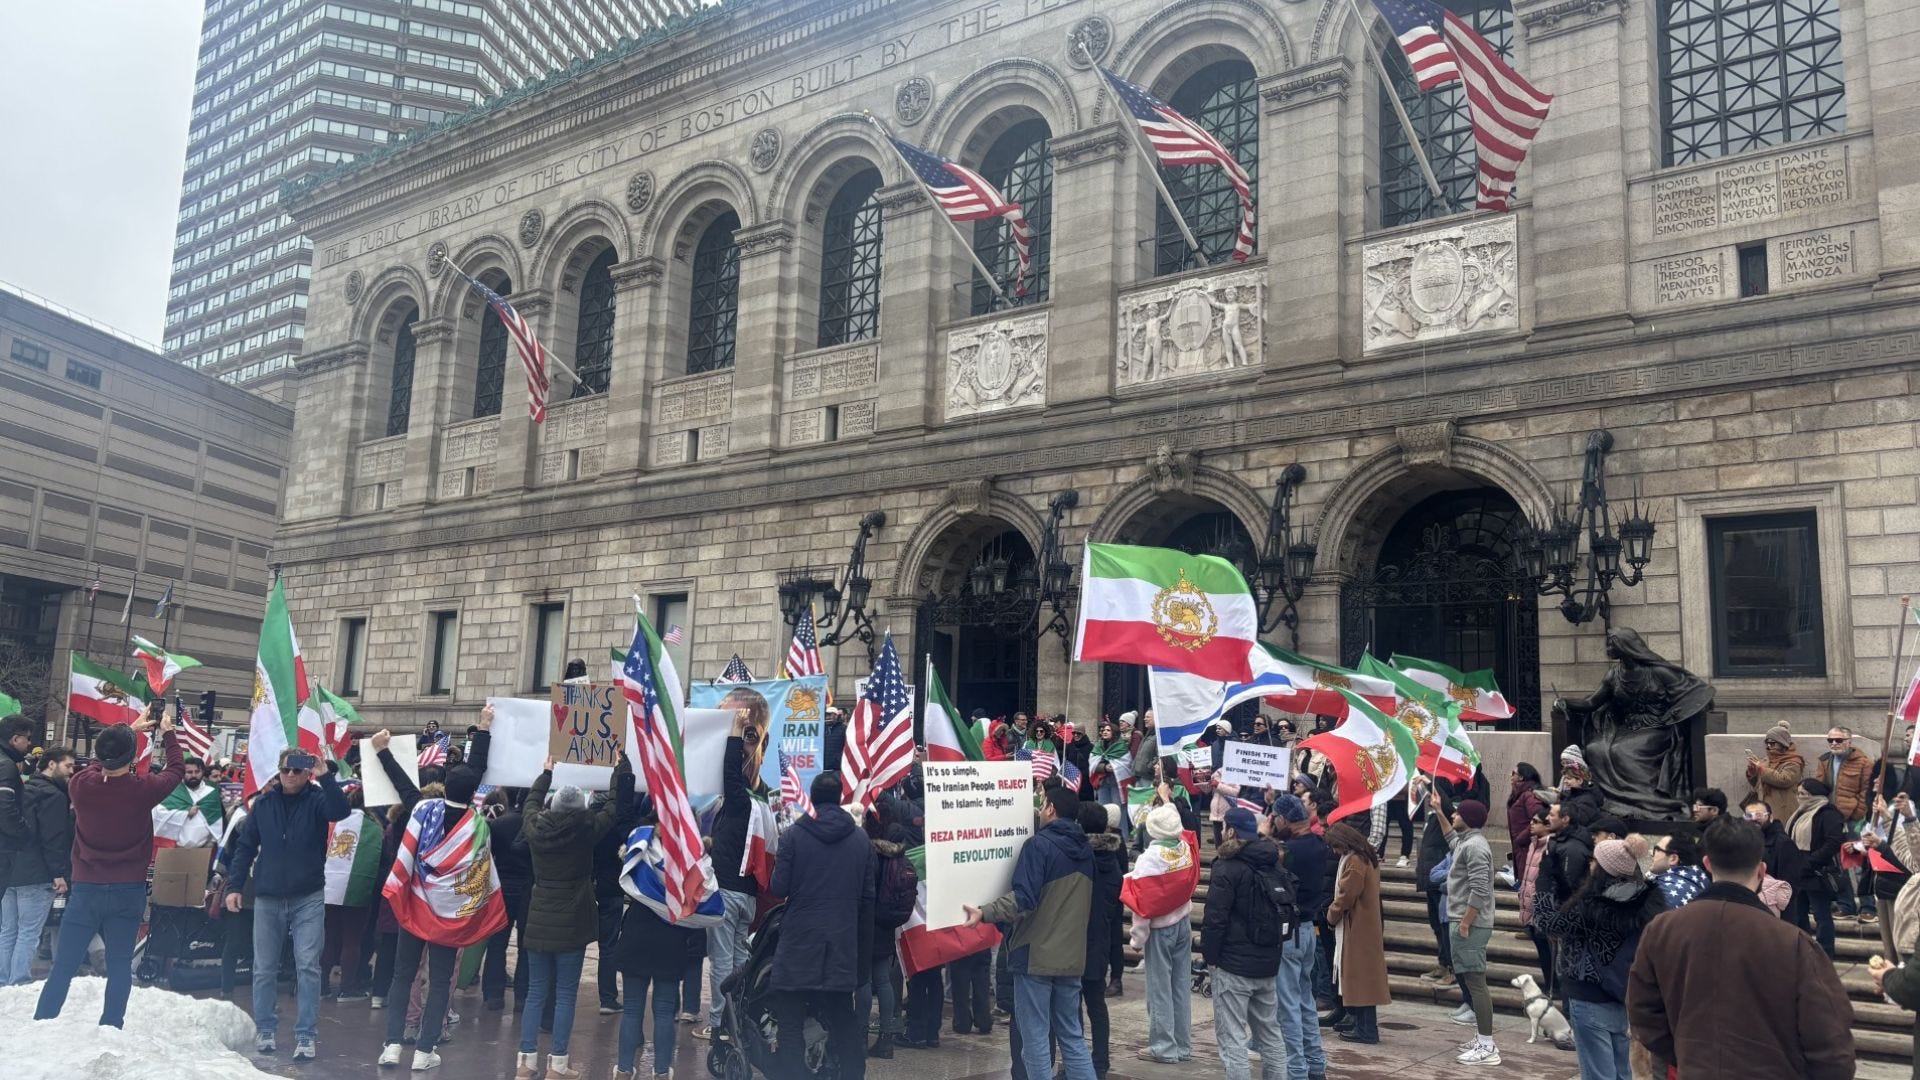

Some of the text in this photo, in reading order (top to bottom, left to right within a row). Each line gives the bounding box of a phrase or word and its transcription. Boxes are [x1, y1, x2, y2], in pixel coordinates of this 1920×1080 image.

[324, 243, 349, 266] THE
[359, 222, 406, 256] PUBLIC
[418, 191, 484, 235] LIBRARY
[494, 181, 518, 205] OF
[531, 166, 565, 192] THE
[576, 141, 624, 176] CITY
[639, 125, 668, 153] OF
[680, 85, 776, 139] BOSTON
[791, 53, 861, 100] BUILT
[881, 33, 917, 67] BY
[939, 8, 1003, 45] THE
[1781, 149, 1829, 166] DANTE
[1721, 161, 1771, 178] HORACE
[1783, 160, 1826, 176] TASSO
[1657, 176, 1699, 191] HOMER
[1722, 176, 1755, 189] OVID
[1782, 169, 1843, 189] BOCCACCIO
[1657, 186, 1702, 202] SAPPHO
[1783, 180, 1845, 200] METASTASIO
[1657, 195, 1715, 213] ANACREON
[1783, 191, 1843, 211] LEOPARDI
[1656, 217, 1715, 235] SIMONIDES
[1786, 242, 1850, 260] CAMOENS
[1660, 257, 1703, 271] HESIOD
[1787, 254, 1847, 272] MANZONI
[1787, 266, 1842, 283] SPINOZA
[1660, 275, 1720, 292] MENANDER
[1661, 286, 1714, 303] PLAVTVS
[783, 723, 819, 737] IRAN
[566, 737, 618, 764] ARMY
[783, 738, 819, 753] WILL
[1235, 749, 1278, 760] FINISH THE
[1241, 757, 1271, 767] REGIME
[927, 766, 979, 777] It's so simple,
[1225, 766, 1248, 775] BEFORE
[1265, 771, 1284, 779] FINISH
[927, 779, 1028, 793] The Iranian People REJECT
[941, 797, 1014, 810] the Islamic Regime!
[930, 826, 1028, 843] REZA PAHLAVI Leads this
[953, 847, 1013, 864] REVOLUTION!
